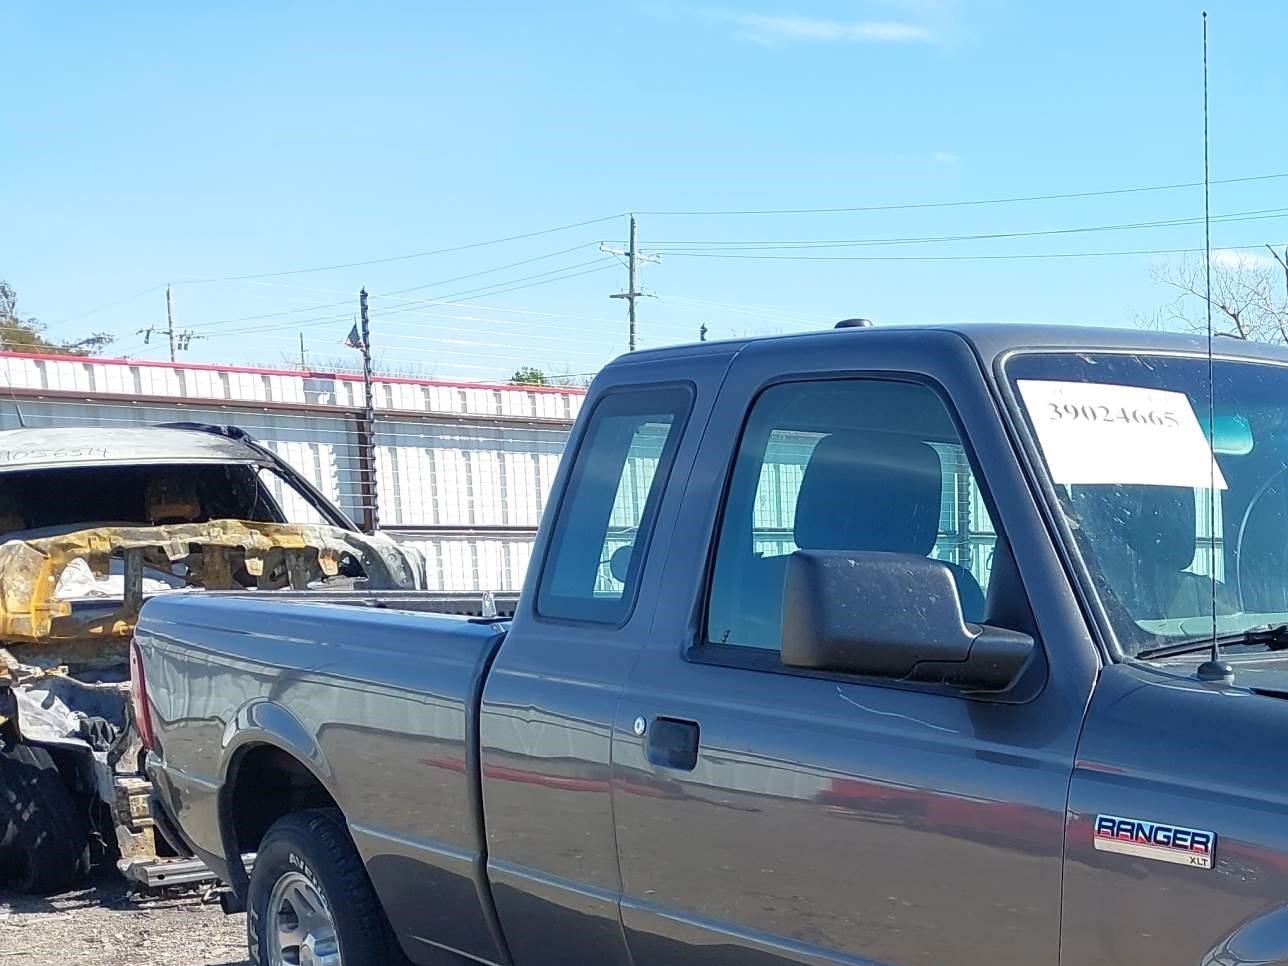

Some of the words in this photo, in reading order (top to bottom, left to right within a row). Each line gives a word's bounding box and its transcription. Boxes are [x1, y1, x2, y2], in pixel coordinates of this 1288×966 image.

[1047, 402, 1180, 428] 39024665
[1097, 816, 1212, 853] RANGER
[1190, 856, 1208, 867] XLT
